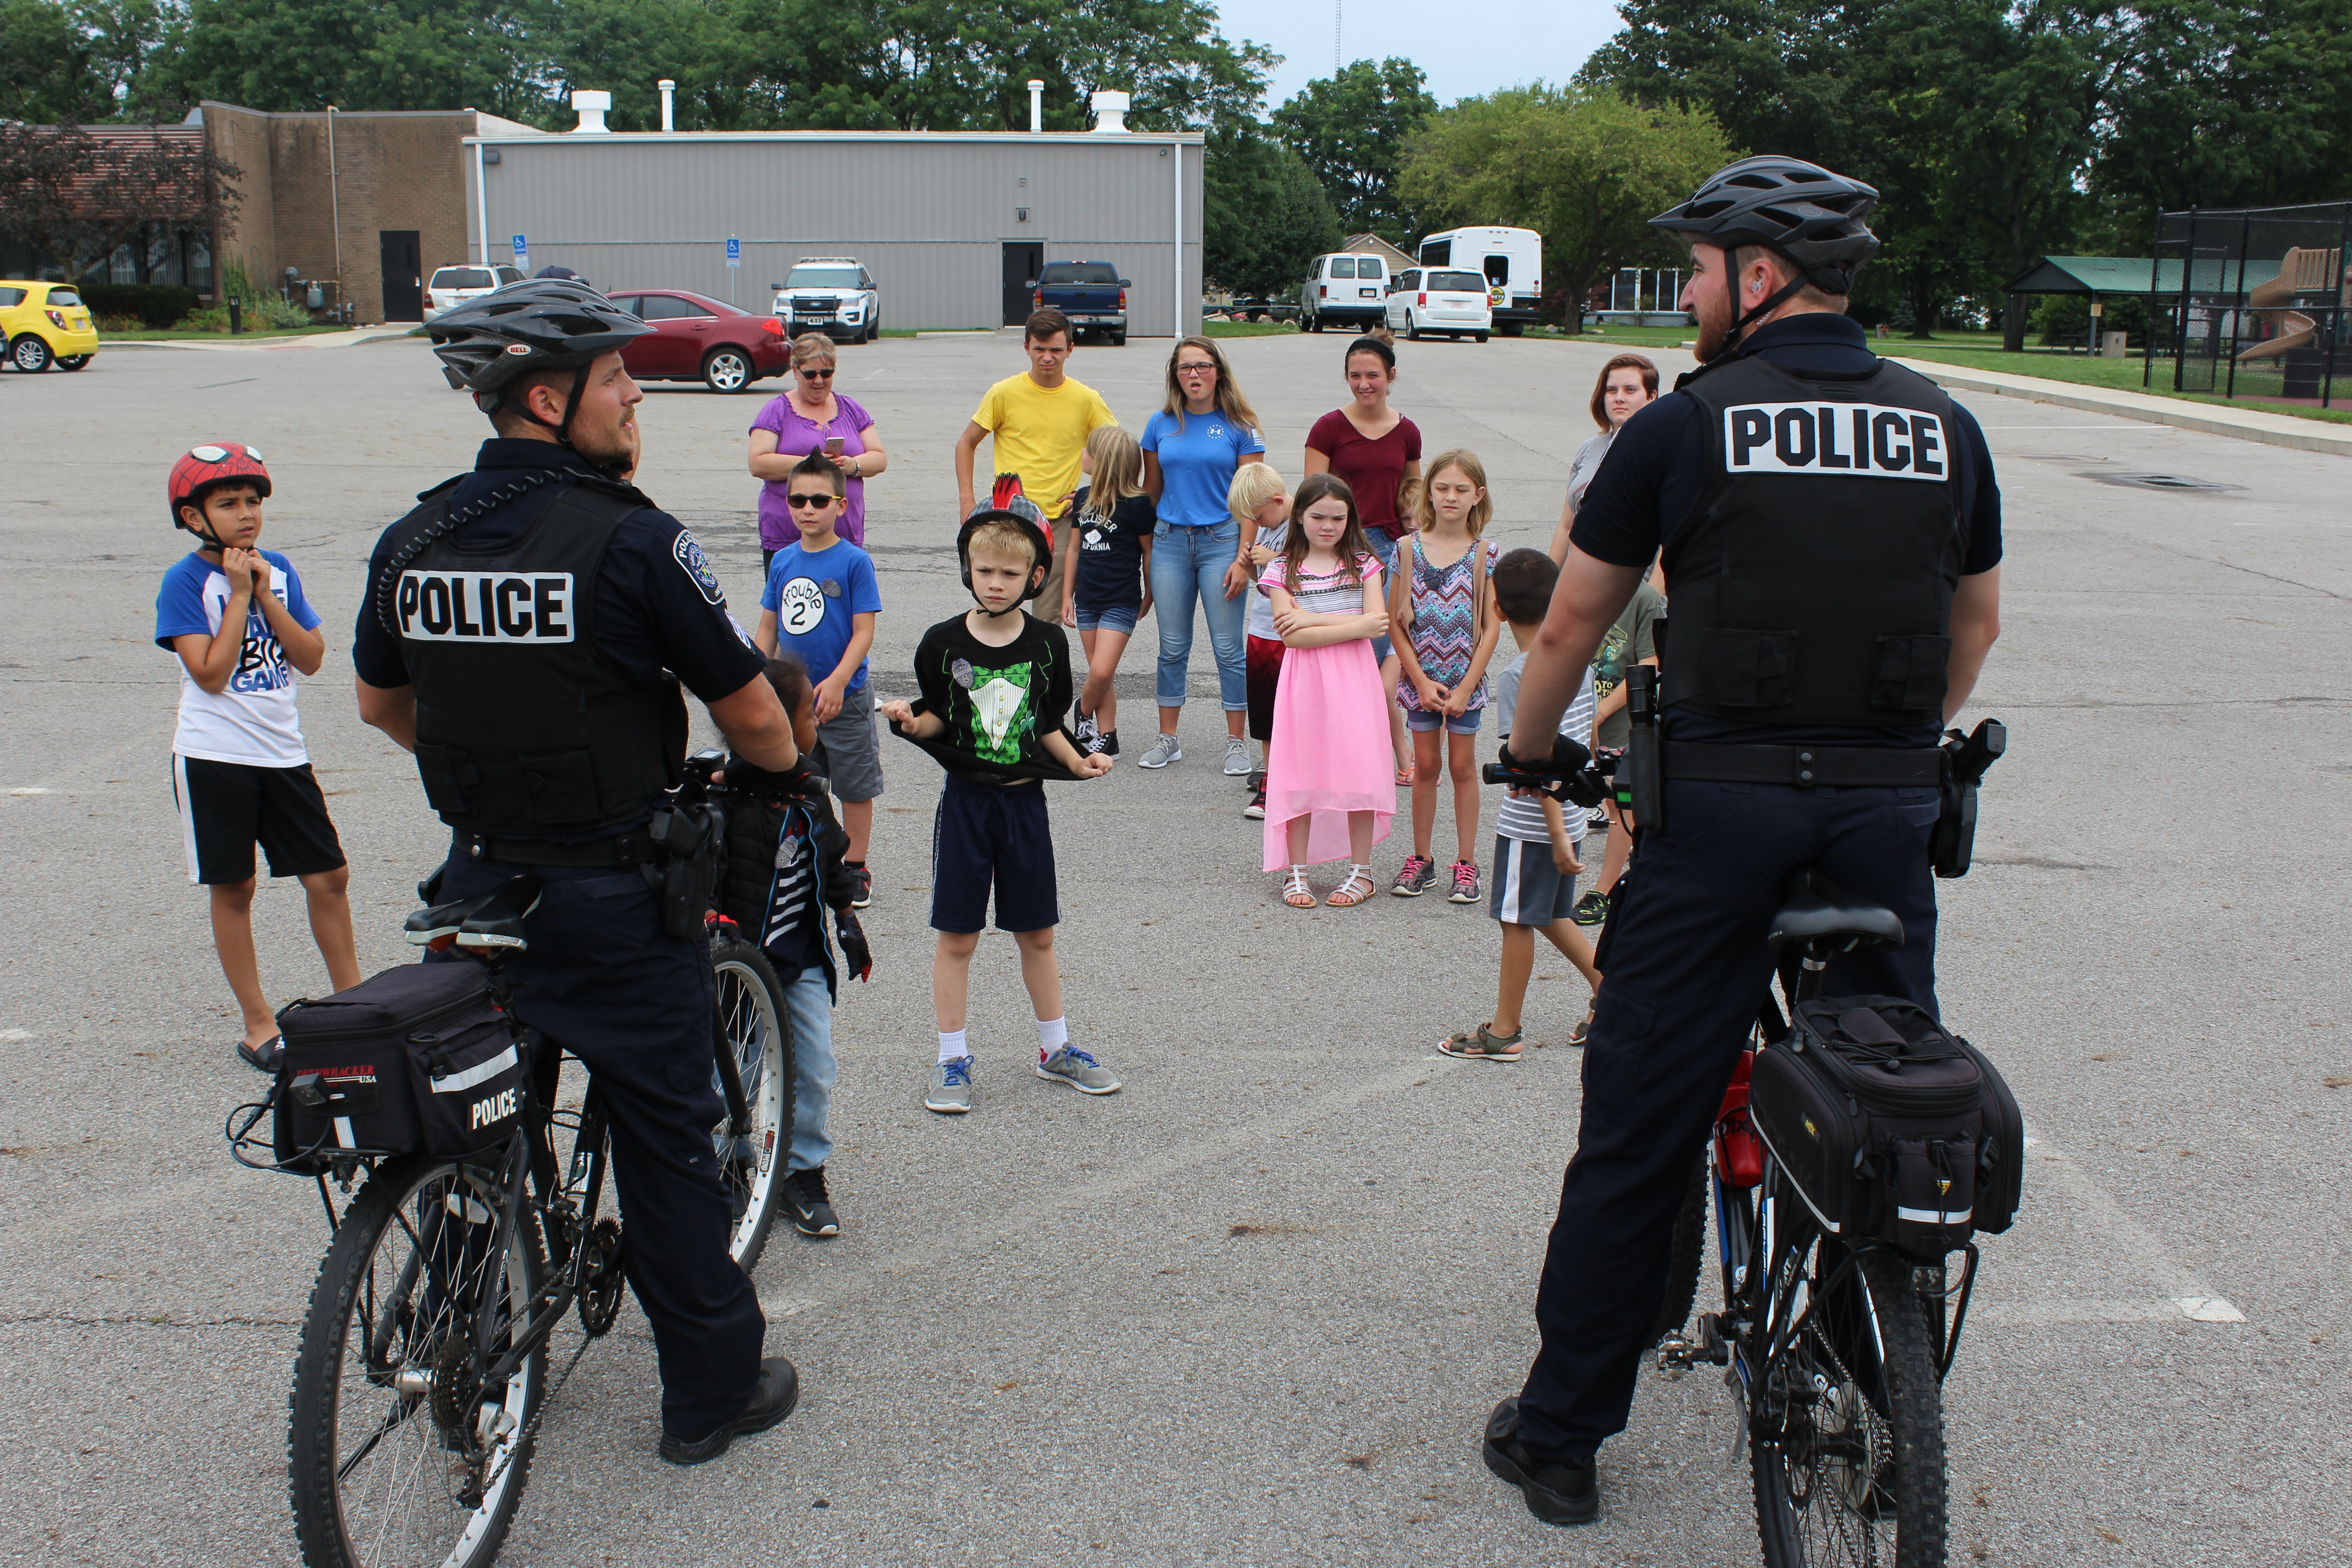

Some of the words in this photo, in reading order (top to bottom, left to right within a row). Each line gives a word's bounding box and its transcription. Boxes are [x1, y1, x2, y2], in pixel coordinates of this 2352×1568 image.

[1732, 407, 1942, 475] POLICE
[1082, 541, 1110, 551] ALIFORNIA
[1089, 533, 1097, 541] 19
[399, 576, 568, 637] POLICE
[784, 582, 822, 609] trouble
[790, 602, 805, 626] 2
[236, 636, 284, 674] BIG
[231, 666, 289, 692] GAME
[1601, 681, 1613, 689] TO
[473, 1088, 516, 1130] POLICE
[1814, 1374, 1840, 1402] GIA
